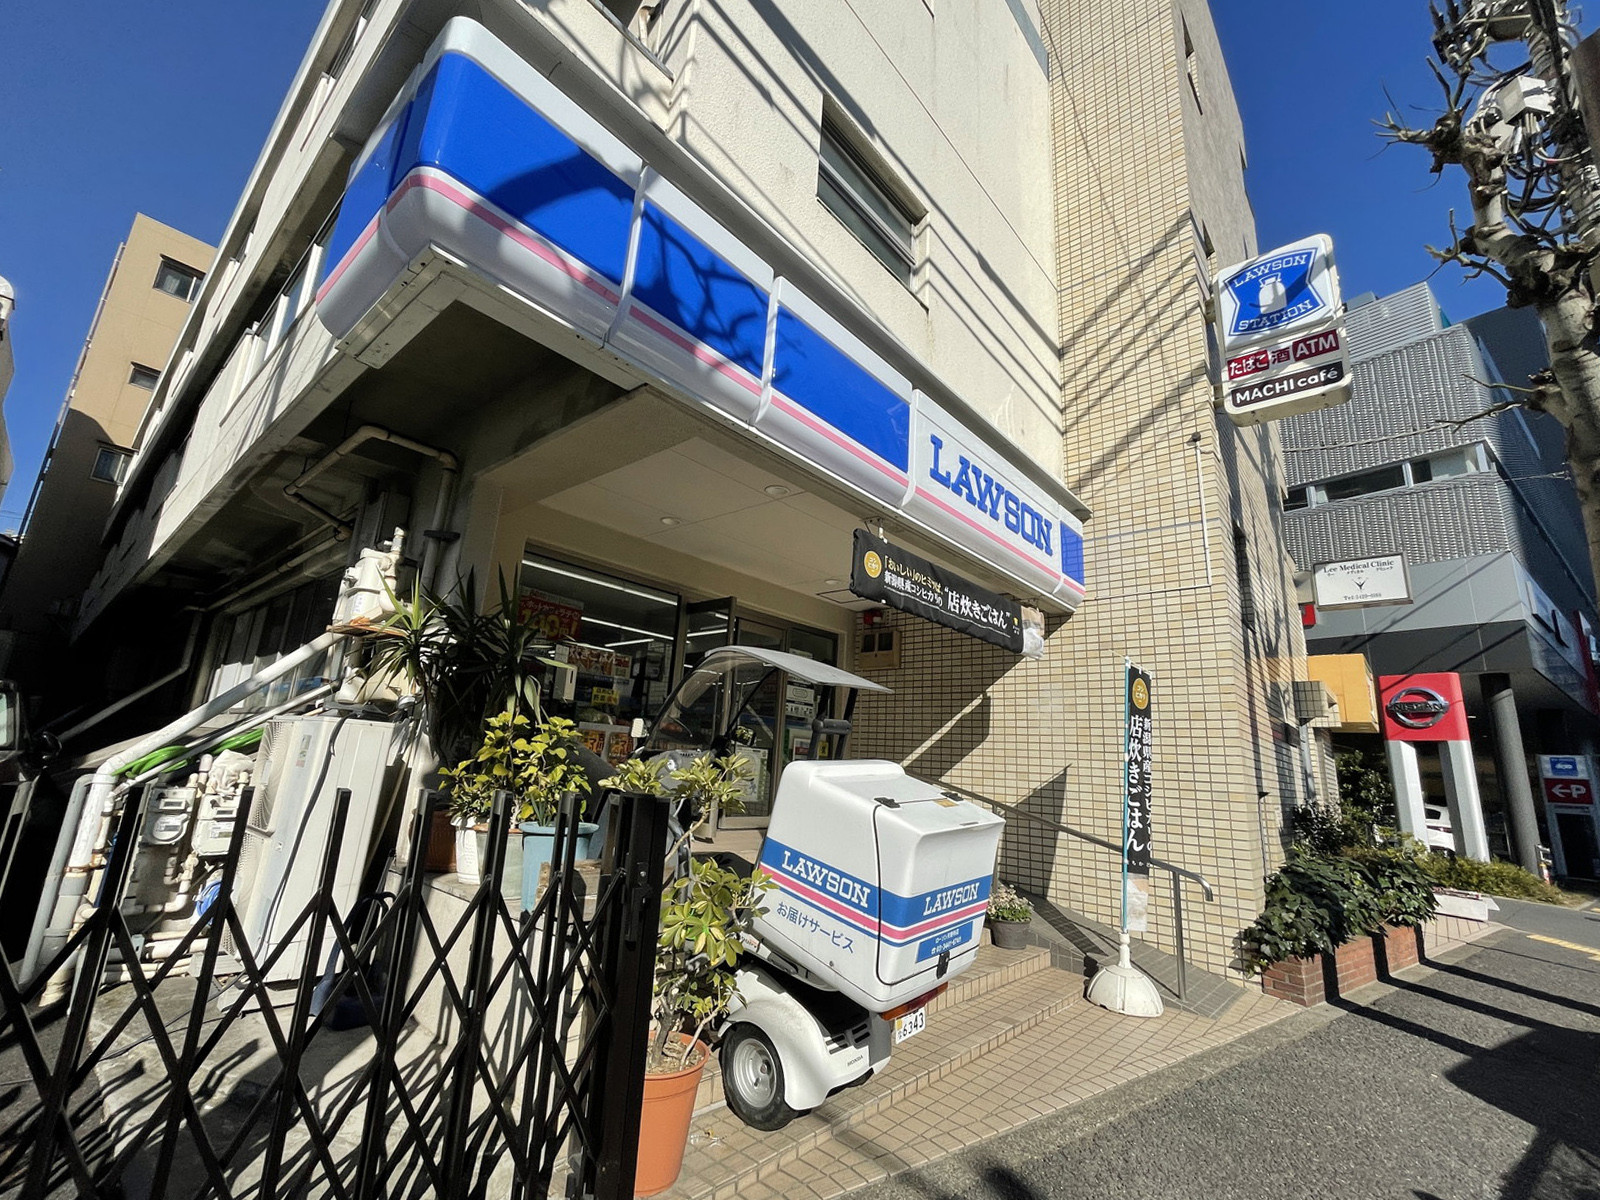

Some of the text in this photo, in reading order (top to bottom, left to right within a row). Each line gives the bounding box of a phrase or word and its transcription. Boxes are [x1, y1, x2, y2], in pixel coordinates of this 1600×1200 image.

[1233, 254, 1308, 288] LAWSON
[1238, 299, 1313, 330] STATION
[1230, 353, 1268, 376] たばこ
[1295, 334, 1337, 358] ATM
[1236, 367, 1338, 404] MACHI café
[930, 433, 1053, 557] LAWSON
[1339, 561, 1370, 571] Medical
[1371, 559, 1395, 568] Clinic
[1127, 714, 1144, 852] 店炊きごはん
[1570, 784, 1586, 798] P
[781, 850, 871, 908] LAWSON
[923, 882, 980, 916] LAWSON
[776, 901, 853, 954] お届けサービス
[902, 1012, 924, 1037] 6343
